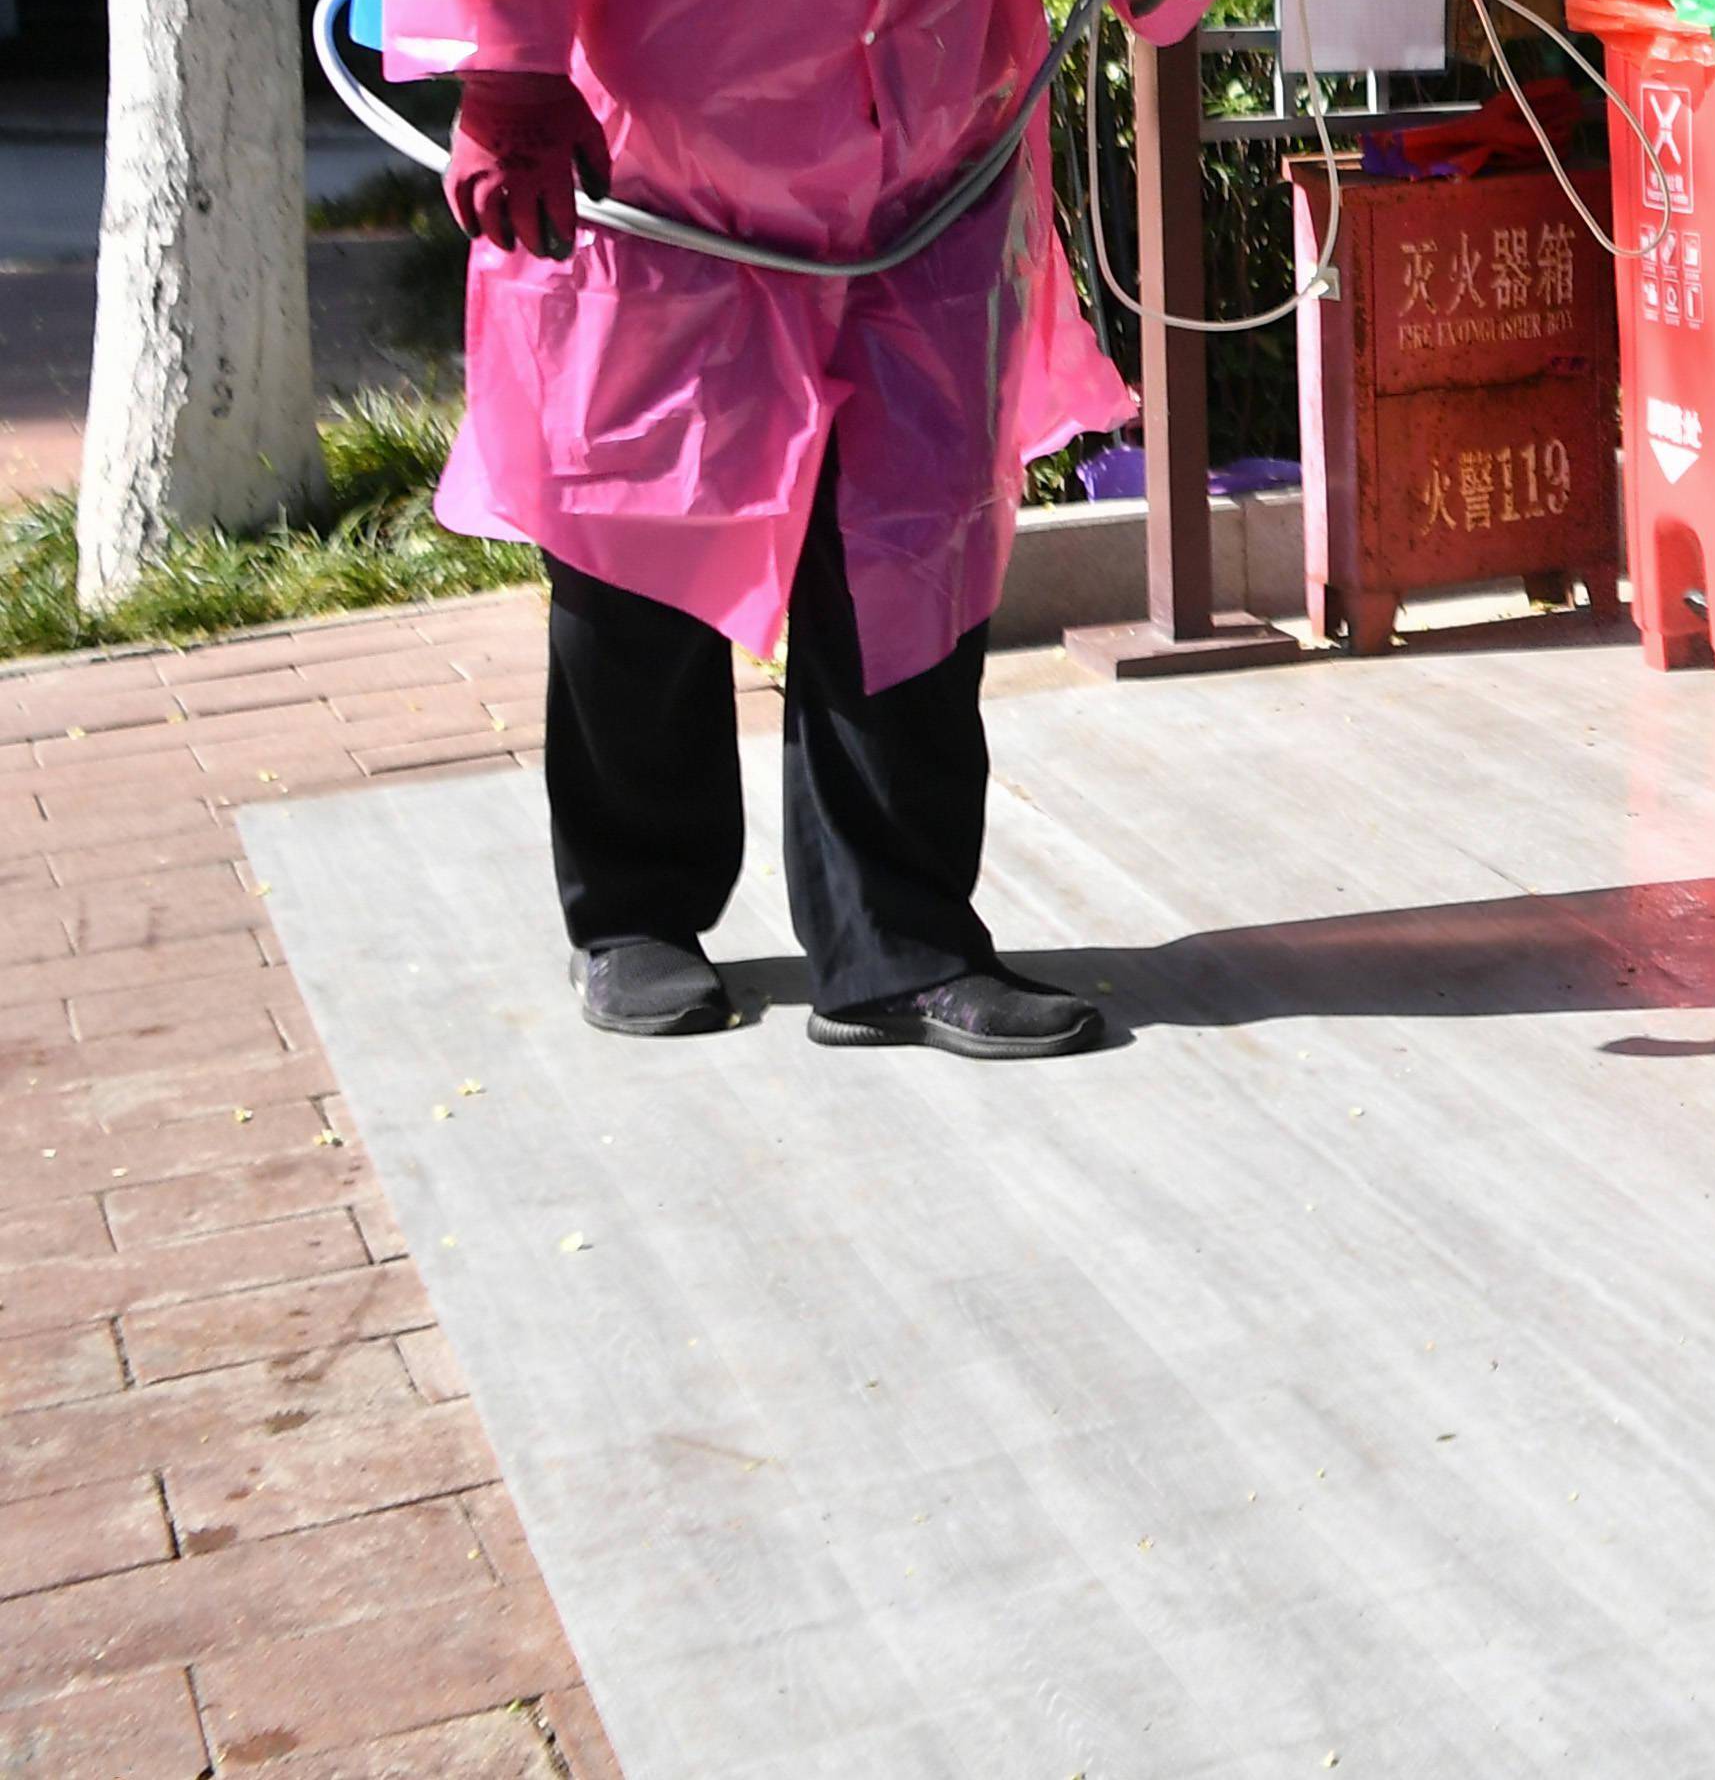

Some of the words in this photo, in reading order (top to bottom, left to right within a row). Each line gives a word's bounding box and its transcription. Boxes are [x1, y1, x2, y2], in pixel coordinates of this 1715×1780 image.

[1399, 223, 1576, 317] 灭火器箱
[1419, 436, 1573, 540] 火警119
